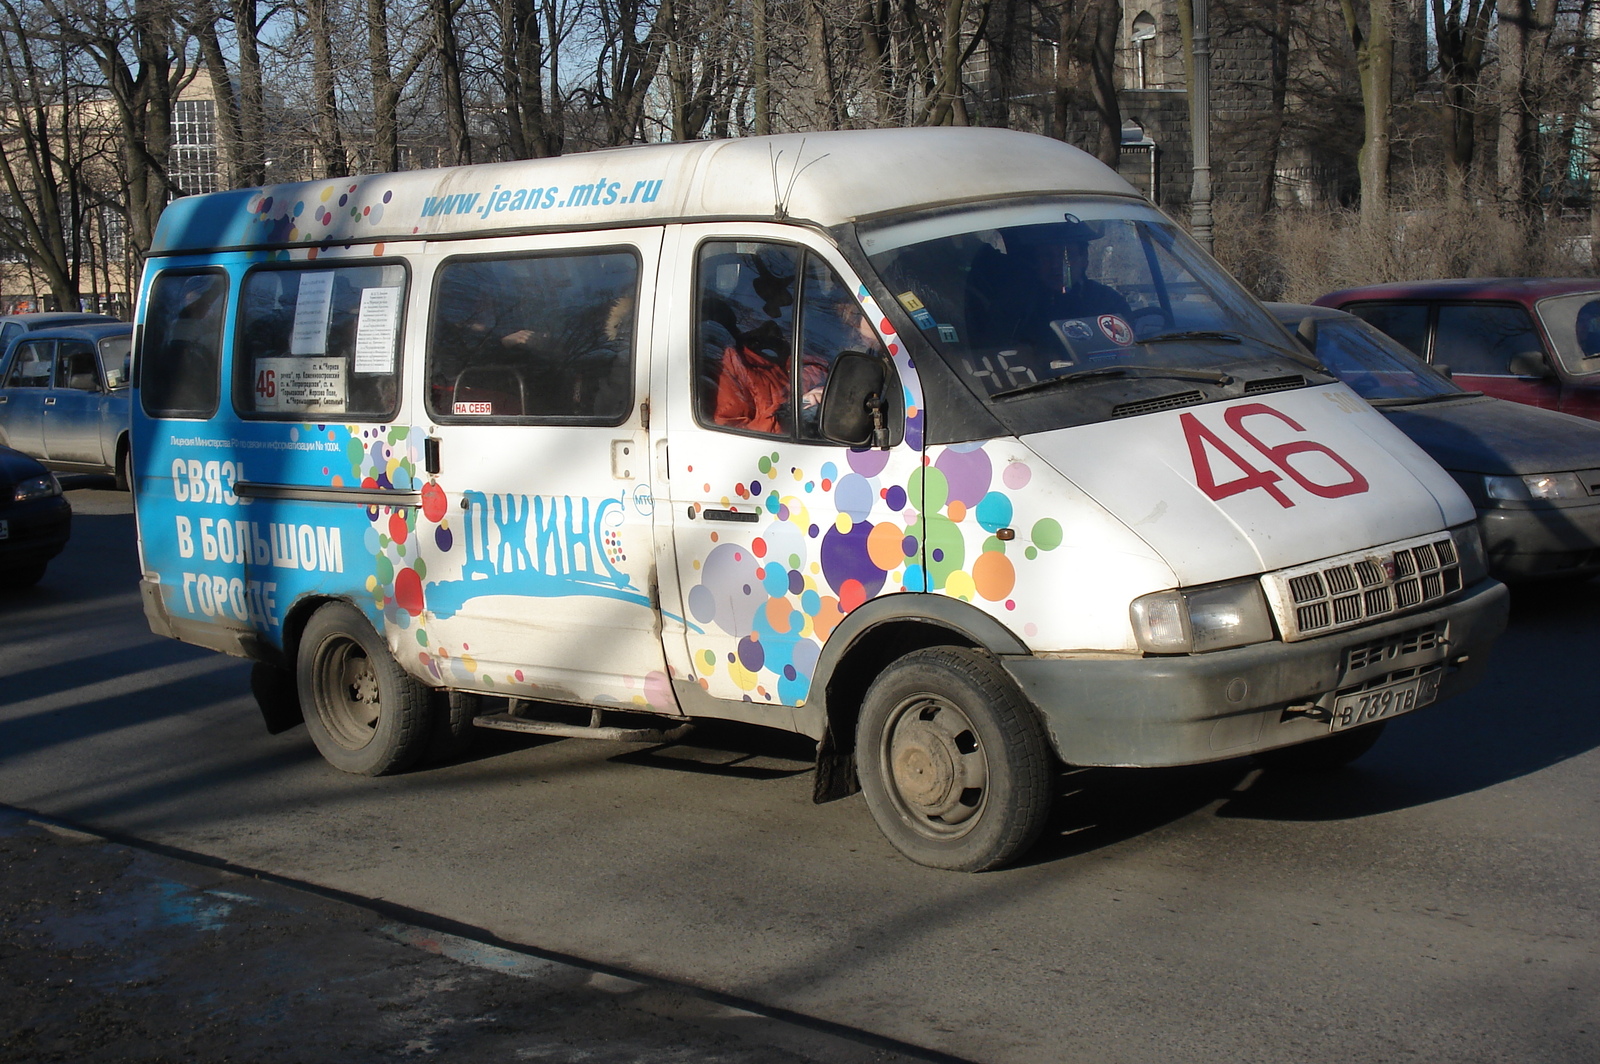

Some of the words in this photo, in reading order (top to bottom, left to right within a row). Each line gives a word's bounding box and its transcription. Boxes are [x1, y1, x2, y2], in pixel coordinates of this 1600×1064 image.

[420, 178, 663, 219] www.jeans.mts.ru
[256, 370, 276, 398] 46
[456, 404, 466, 413] НА
[469, 403, 490, 413] СЕБЯ
[172, 458, 254, 506] СВЯЗЬ
[1180, 403, 1370, 509] 46
[176, 516, 194, 558] В
[200, 518, 343, 573] БОЛЬШОМ
[462, 490, 630, 588] ДЖИНС
[183, 572, 279, 631] ГОРОДЕ
